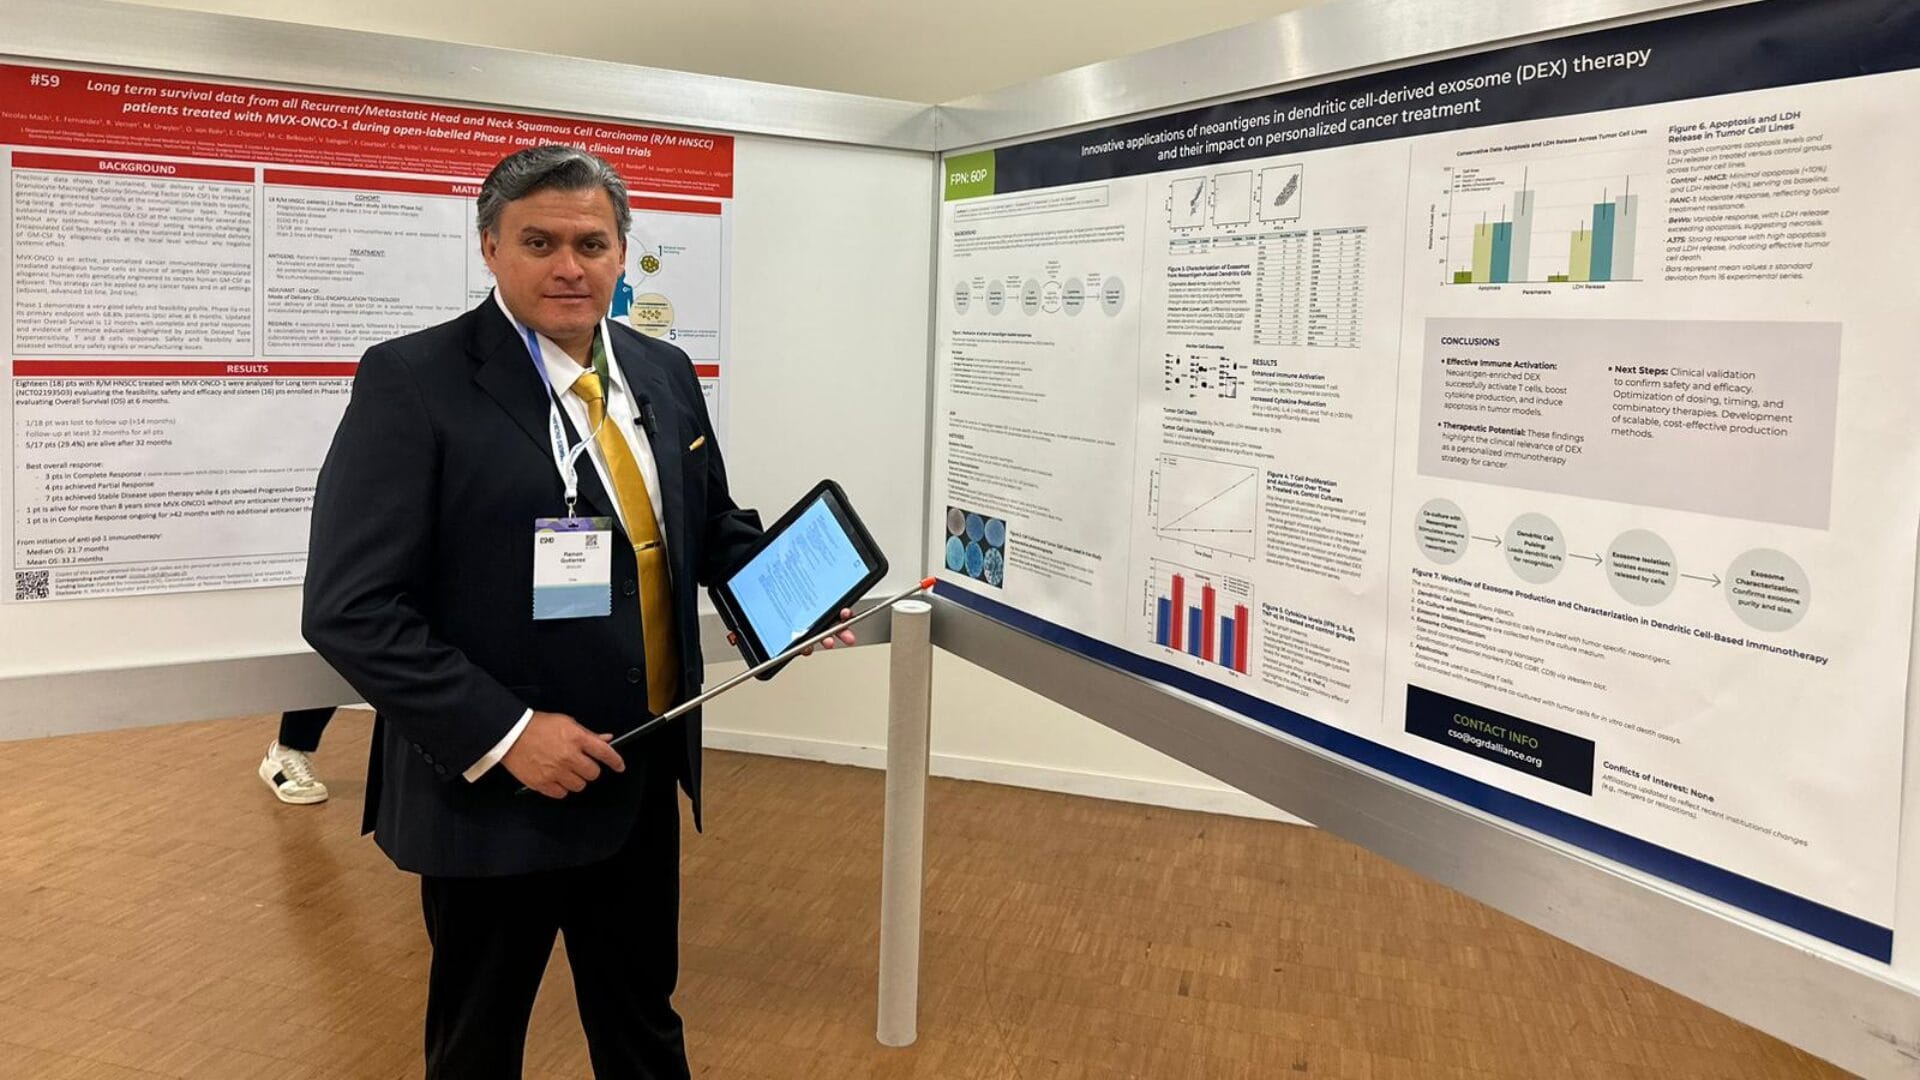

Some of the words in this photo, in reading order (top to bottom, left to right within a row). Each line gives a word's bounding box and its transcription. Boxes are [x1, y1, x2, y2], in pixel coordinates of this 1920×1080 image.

[30, 74, 59, 86] #59
[1081, 140, 1124, 155] Innovative
[1126, 130, 1184, 148] applications
[1186, 124, 1198, 137] of
[1199, 115, 1270, 134] neoantigens
[1273, 110, 1284, 123] in
[1287, 101, 1346, 120] dendritic
[1349, 82, 1434, 109] cell-derived
[1438, 72, 1511, 93] exosome
[1516, 59, 1566, 84] (DEX)
[1573, 49, 1651, 71] therapy
[86, 80, 120, 94] Long
[124, 84, 156, 95] term
[159, 89, 212, 100] survival
[215, 92, 245, 103] data
[246, 94, 279, 106] from
[281, 98, 298, 108] all
[300, 100, 427, 119] Recurrent/Metastatic
[430, 112, 460, 123] Head
[462, 116, 484, 125] and
[486, 117, 513, 128] Neck
[515, 120, 570, 133] Squamous
[573, 126, 593, 136] Cell
[594, 128, 648, 141] Carcinoma
[650, 134, 676, 144] (R/M
[677, 137, 713, 149] HNSCC)
[1668, 124, 1697, 134] Figure
[1698, 122, 1707, 132] 6.
[1708, 117, 1756, 128] Apoptosis
[1757, 114, 1777, 123] and
[1779, 111, 1800, 120] LDH
[122, 102, 178, 114] patients
[182, 107, 231, 119] treated
[234, 111, 262, 121] with
[265, 113, 347, 128] MVX-ONCO-1
[351, 121, 390, 134] during
[392, 126, 471, 139] open-labelled
[472, 131, 506, 142] Phase
[508, 135, 512, 143] I
[514, 137, 536, 145] and
[572, 140, 586, 151] IIA
[587, 143, 624, 156] clinical
[626, 147, 651, 156] trials
[1157, 146, 1177, 160] and
[1179, 142, 1203, 156] their
[1205, 137, 1245, 153] impact
[1247, 135, 1262, 146] on
[1265, 119, 1346, 145] personalized
[1349, 113, 1398, 130] cancer
[1401, 98, 1480, 121] treatment
[1668, 134, 1702, 142] Release
[1715, 129, 1745, 137] Tumor
[1747, 125, 1766, 134] Cell
[1768, 123, 1794, 132] Lines
[98, 161, 175, 173] BACKGROUND
[950, 173, 969, 186] FPN:
[970, 168, 988, 183] 60P
[658, 245, 662, 256] 1
[669, 329, 677, 341] 5
[1440, 337, 1500, 345] CONCLUSIONS
[1445, 369, 1522, 379] Neoantigen-enriched
[1523, 372, 1540, 380] DEX
[1513, 361, 1557, 369] Activation:
[1614, 365, 1636, 373] Next
[1638, 366, 1668, 376] Steps:
[1670, 367, 1704, 376] Clinical
[1706, 370, 1755, 378] validation
[1444, 381, 1486, 390] successfully
[1523, 384, 1543, 392] cells,
[1544, 385, 1567, 394] boost
[1624, 378, 1661, 387] confirm
[1662, 380, 1690, 391] safety
[1691, 382, 1711, 390] and
[1712, 382, 1753, 394] efficacy.
[1475, 394, 1517, 402] production,
[1535, 397, 1563, 405] induce
[1613, 390, 1673, 400] Optimization
[1674, 393, 1685, 401] of
[1686, 394, 1721, 406] dosing,
[1723, 396, 1760, 408] timing,
[1762, 400, 1784, 408] and
[1612, 403, 1670, 415] combinatory
[1672, 407, 1718, 417] therapies.
[1721, 409, 1792, 422] Development
[1443, 421, 1486, 432] Therapeutic
[1488, 425, 1526, 435] Potential:
[1527, 429, 1549, 438] These
[1551, 431, 1584, 442] findings
[1610, 428, 1654, 438] methods.
[1611, 414, 1621, 422] of
[1622, 416, 1661, 426] scalable,
[1662, 420, 1727, 430] cost-effective
[1728, 425, 1787, 435] production
[1441, 432, 1474, 442] highlight
[1488, 437, 1515, 446] clinical
[1516, 440, 1553, 450] relevance
[1564, 444, 1582, 453] DEX
[1456, 446, 1502, 456] personalized
[1503, 451, 1566, 465] immunotherapy
[1412, 567, 1433, 578] Figure
[1440, 574, 1472, 586] Workflow
[1481, 583, 1513, 595] Exosome
[1514, 590, 1555, 604] Production
[1557, 600, 1571, 608] and
[1572, 603, 1638, 622] Characterization
[1640, 616, 1648, 625] in
[1650, 619, 1691, 634] Dendritic
[1693, 629, 1743, 645] Cell-Based
[1745, 640, 1828, 664] Immunotherapy
[1453, 713, 1507, 739] CONTACT
[1508, 730, 1538, 749] INFO
[1447, 728, 1543, 768] cso@ogrdalliance.org
[1602, 761, 1640, 777] Conflicts
[1652, 776, 1688, 793] Interest:
[1690, 788, 1714, 802] None
